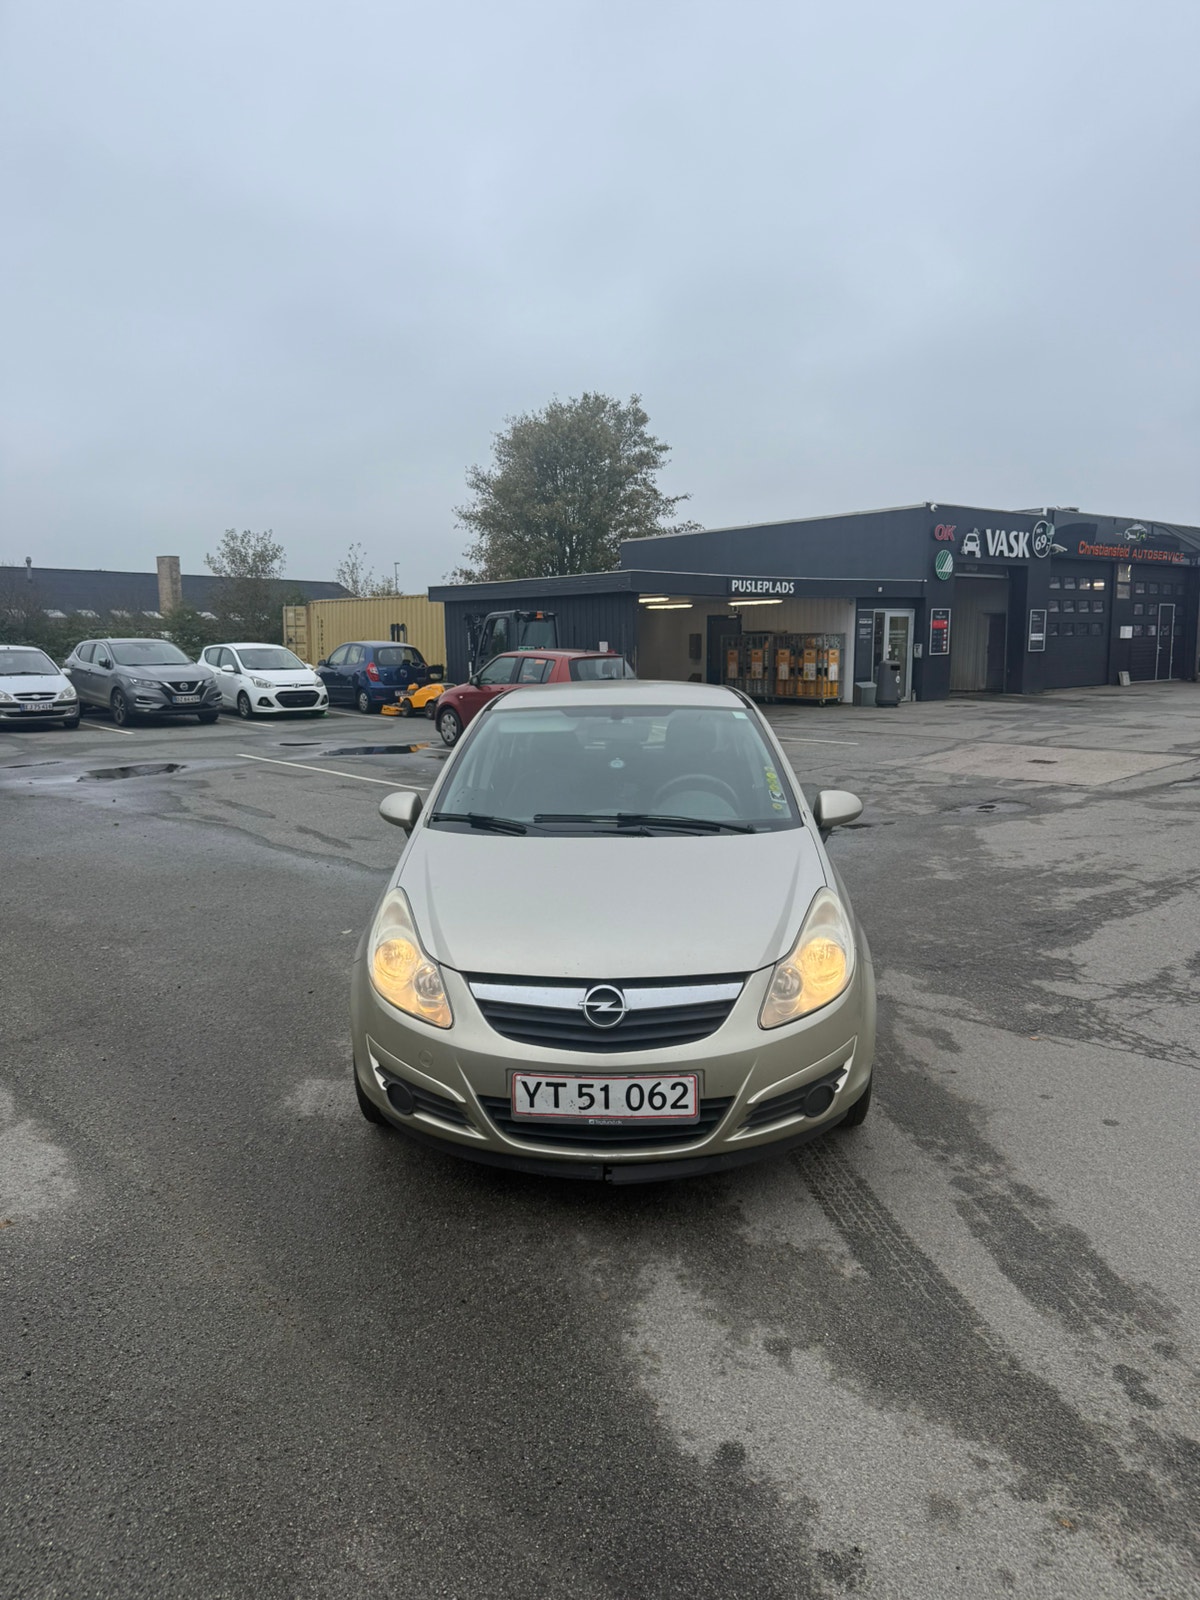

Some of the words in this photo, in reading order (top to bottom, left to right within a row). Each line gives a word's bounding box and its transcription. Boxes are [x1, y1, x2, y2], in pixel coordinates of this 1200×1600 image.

[934, 523, 956, 541] OK
[985, 528, 1030, 558] VASK
[1078, 540, 1131, 558] Christiansfeld
[1131, 548, 1185, 562] AUTOSERVICE
[731, 579, 795, 594] PUSLEPLADS
[521, 1080, 567, 1109] YT
[577, 1083, 610, 1111] 51
[625, 1081, 689, 1112] 062
